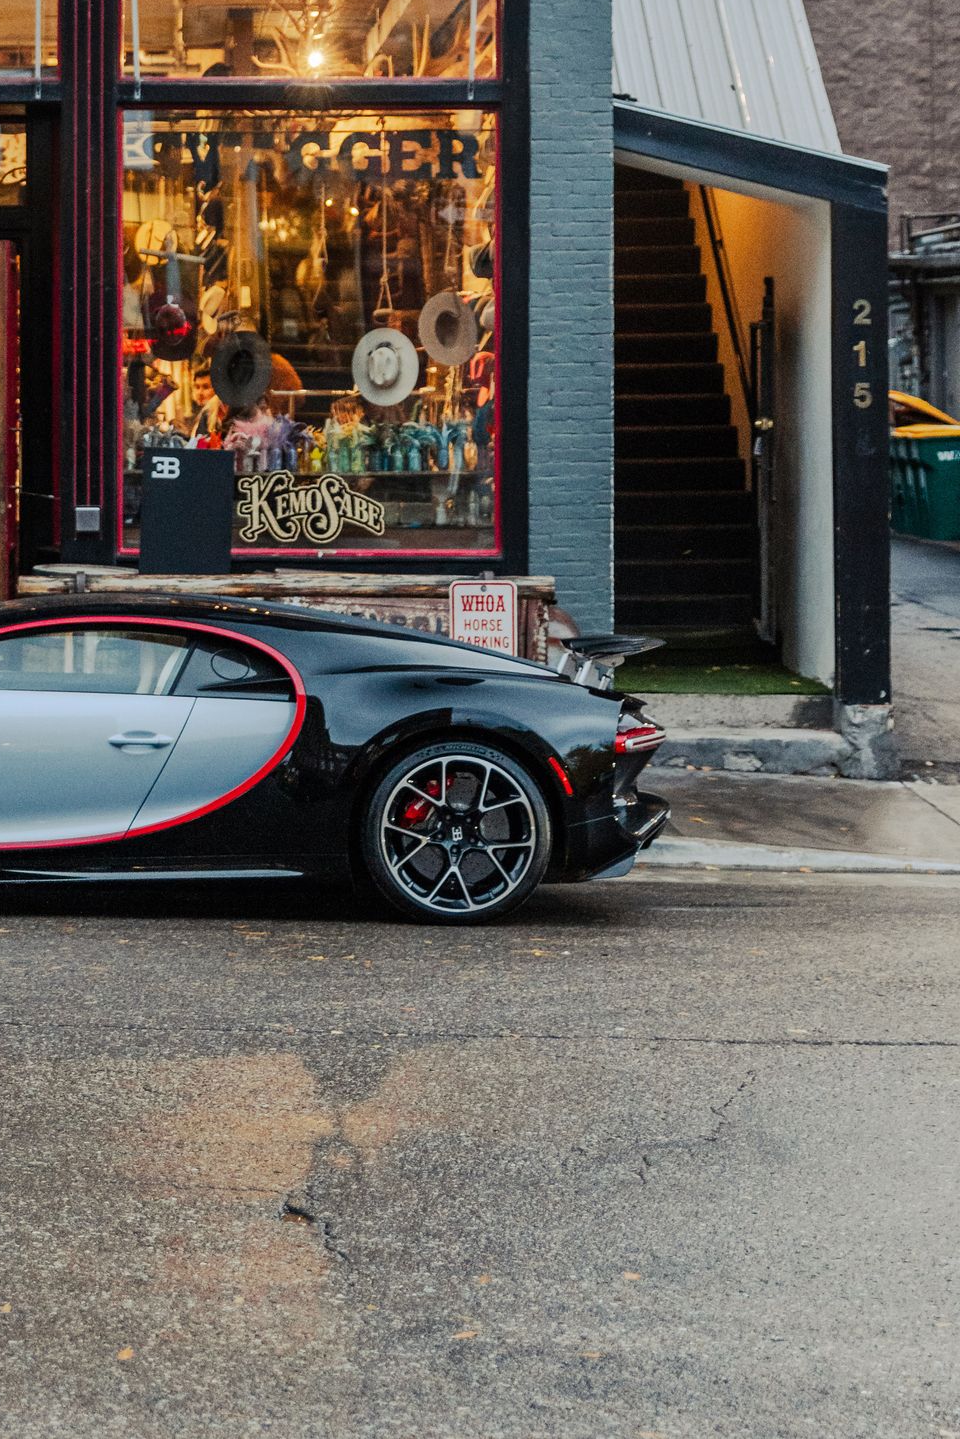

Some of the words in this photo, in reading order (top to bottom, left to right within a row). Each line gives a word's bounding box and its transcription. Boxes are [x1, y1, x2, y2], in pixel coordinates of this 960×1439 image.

[852, 299, 873, 408] 215
[461, 594, 506, 612] WHOA
[464, 619, 503, 631] HORSE
